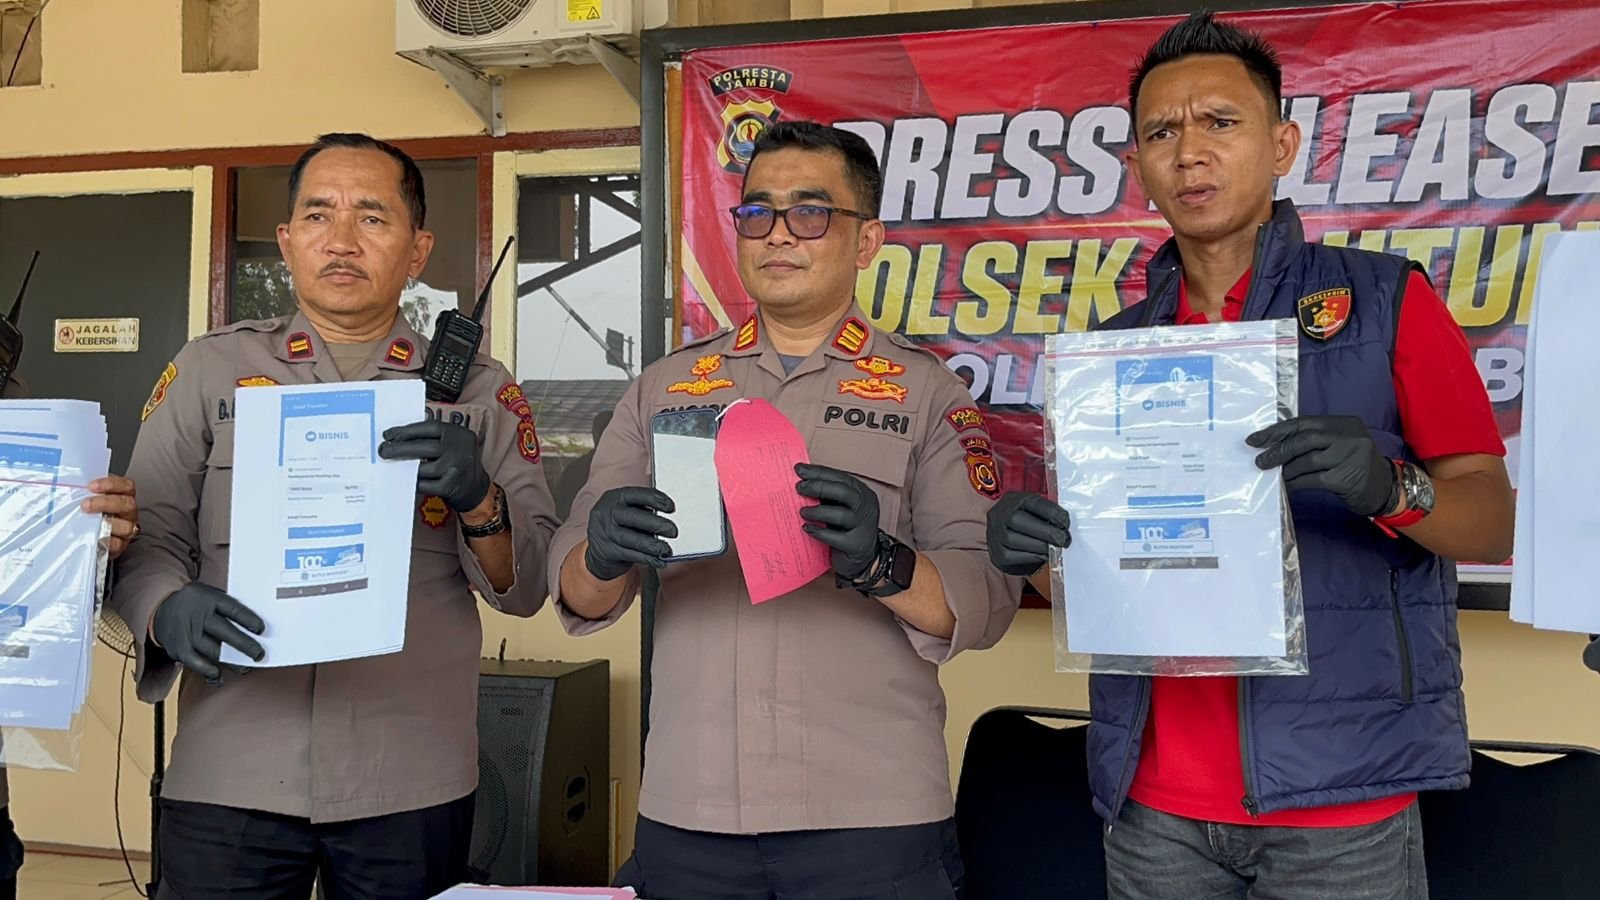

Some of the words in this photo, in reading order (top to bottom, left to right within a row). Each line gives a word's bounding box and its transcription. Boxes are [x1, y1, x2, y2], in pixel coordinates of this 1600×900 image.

[713, 68, 787, 86] POLRESTA
[726, 78, 774, 91] JAMBI
[1148, 82, 1600, 211] LEASE
[855, 237, 1140, 334] OLSEK
[76, 325, 136, 334] JAGALAH
[1156, 399, 1187, 409] BISNIS
[823, 405, 910, 435] POLRI
[319, 431, 350, 440] BISNIS
